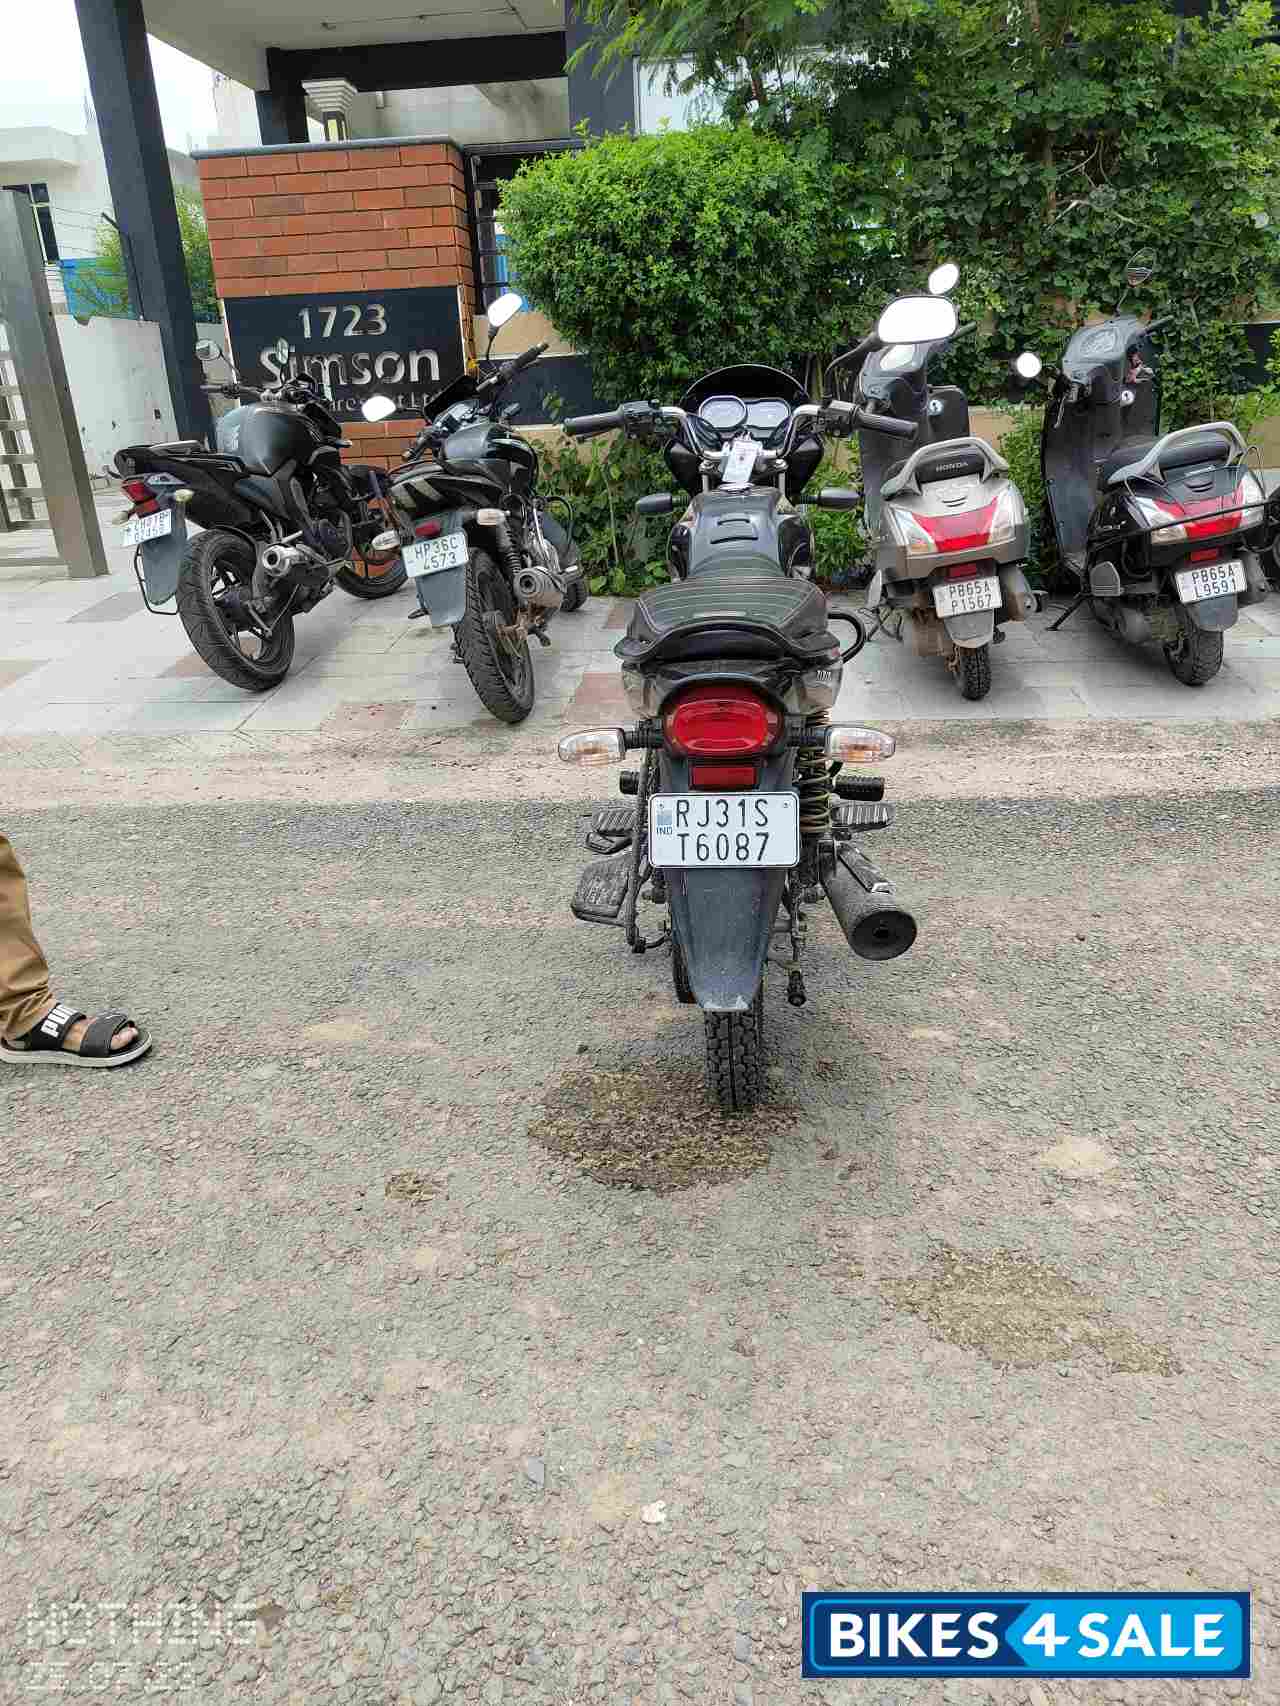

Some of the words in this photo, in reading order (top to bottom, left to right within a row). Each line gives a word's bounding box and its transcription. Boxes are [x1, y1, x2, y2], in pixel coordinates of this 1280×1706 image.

[299, 303, 388, 338] 1723
[259, 345, 441, 388] Simson
[415, 536, 458, 559] HP36C
[1191, 564, 1234, 585] PB65A
[948, 580, 991, 598] PB65A
[1193, 578, 1237, 598] L9591
[951, 594, 992, 615] P1567
[676, 798, 769, 828] RJ31S
[677, 832, 770, 862] T6087
